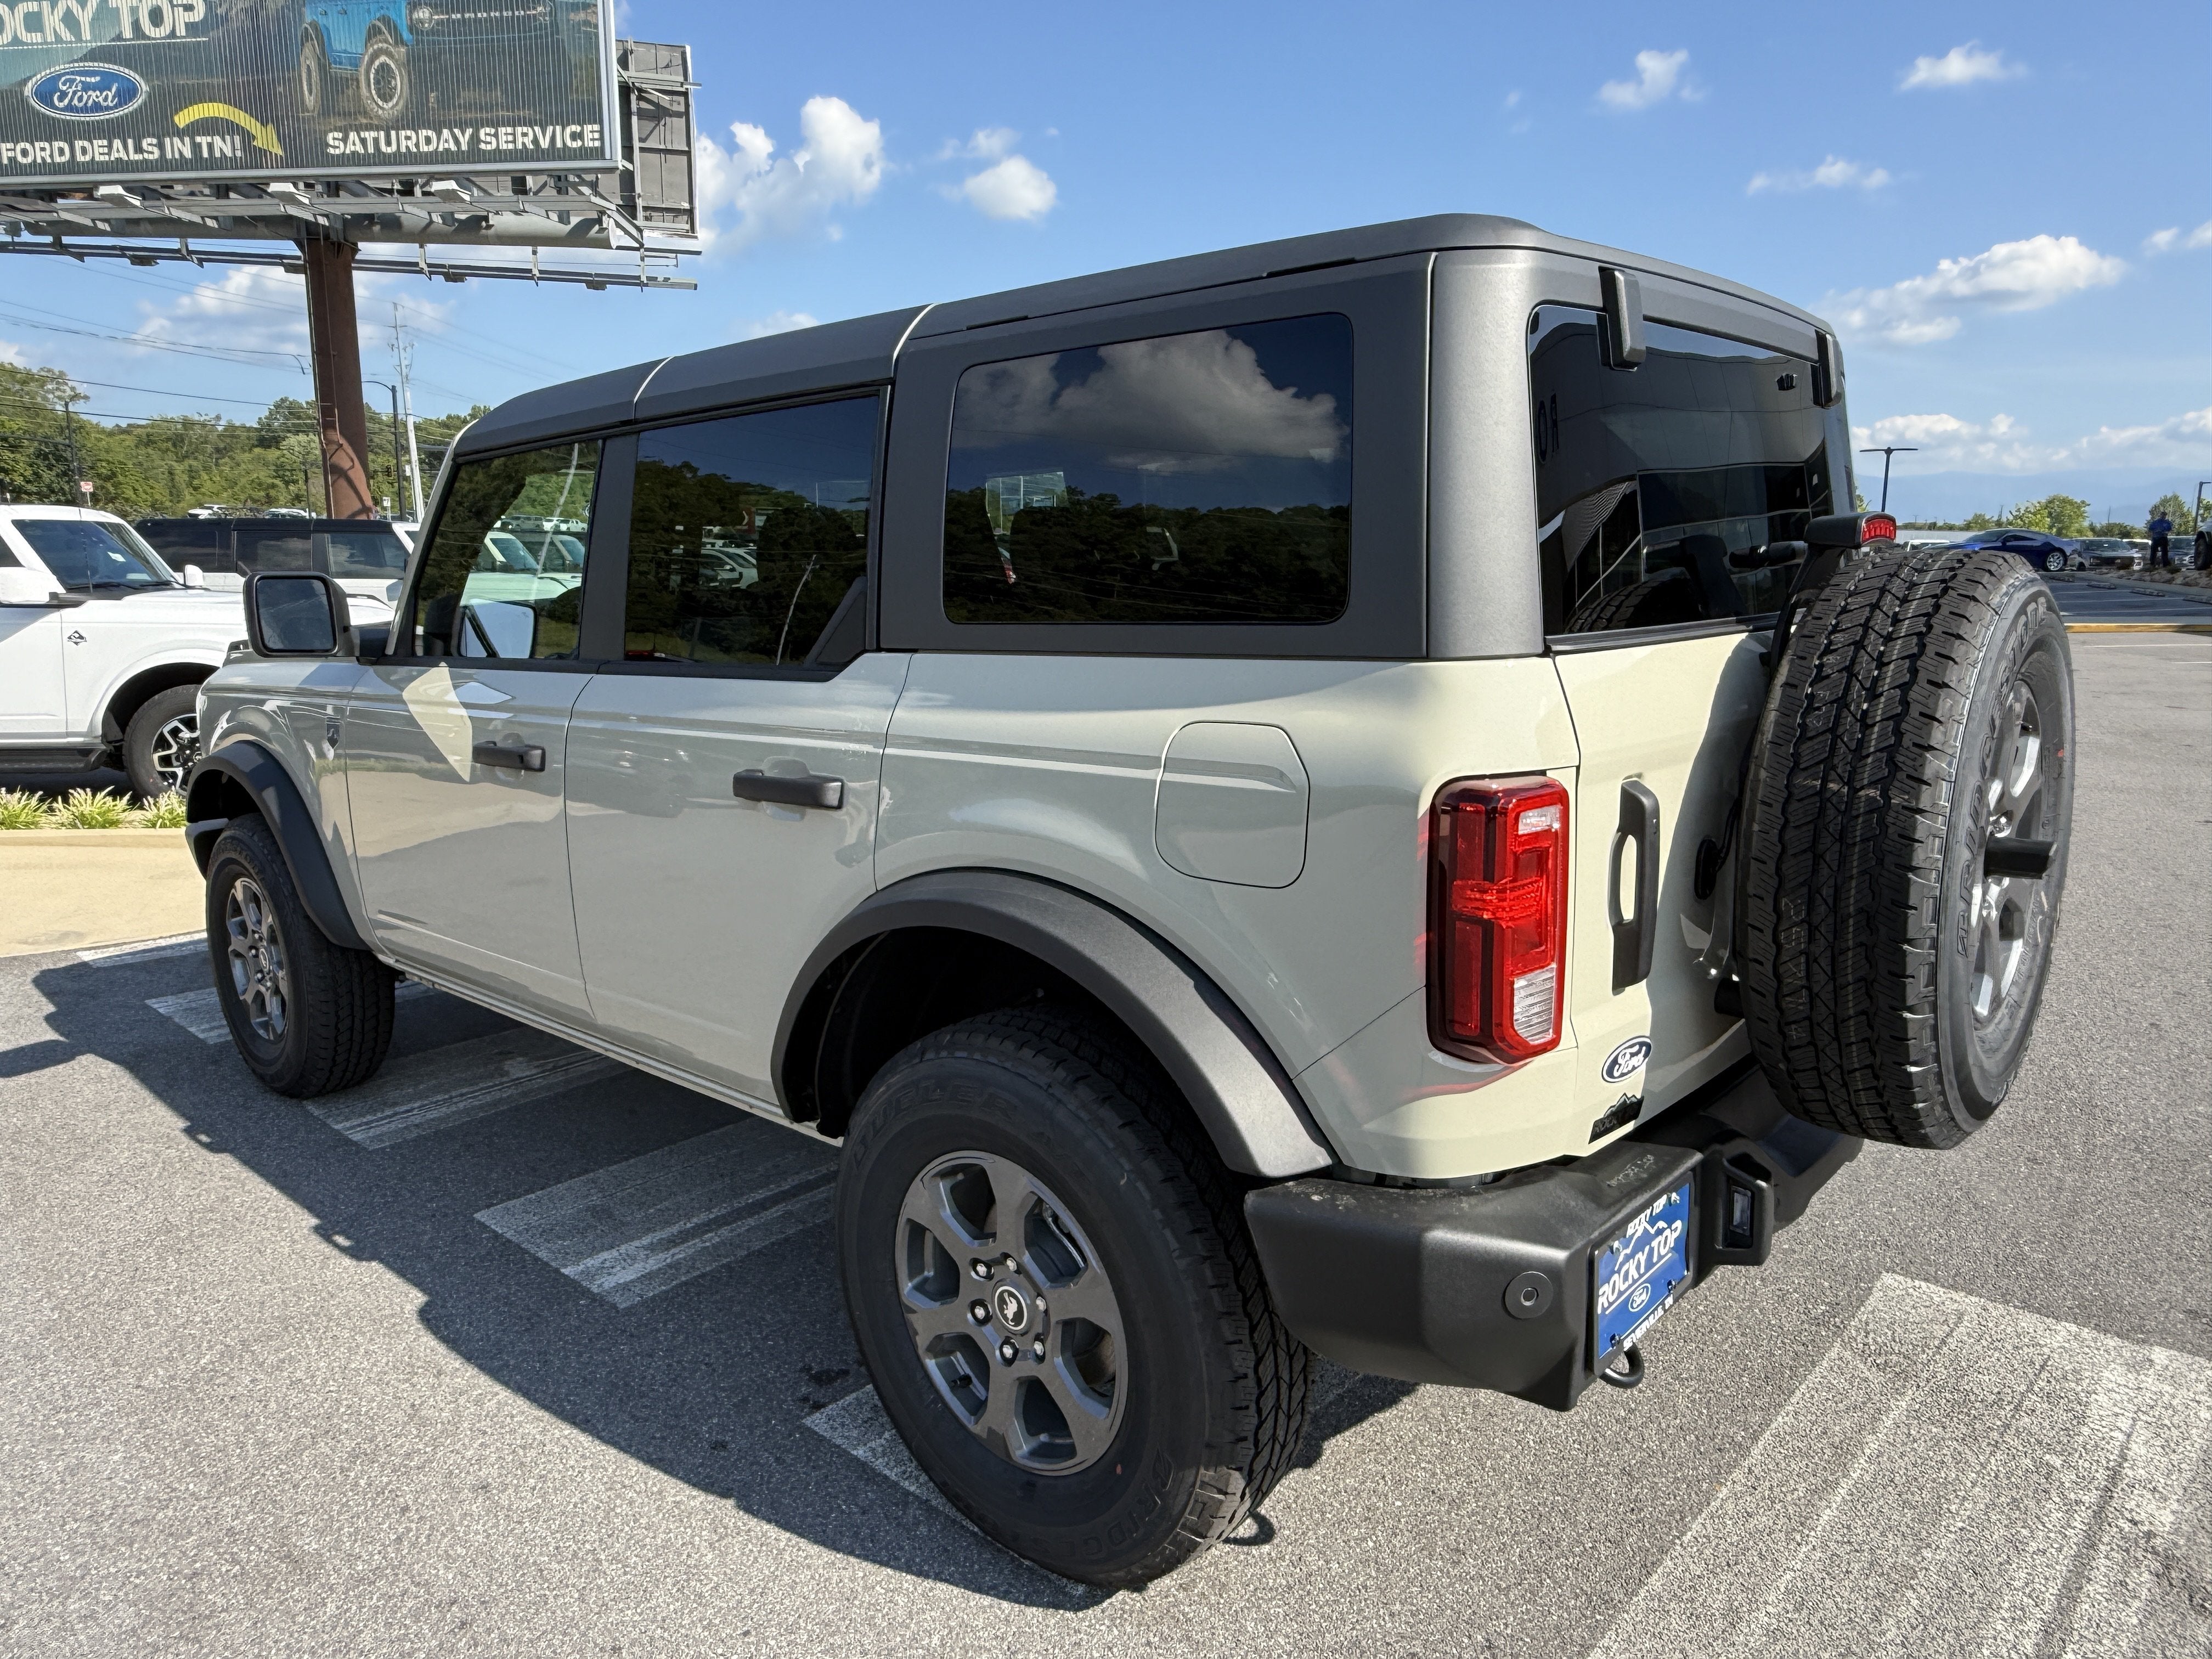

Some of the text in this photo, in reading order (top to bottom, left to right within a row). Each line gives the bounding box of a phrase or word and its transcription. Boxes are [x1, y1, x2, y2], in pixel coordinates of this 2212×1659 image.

[110, 0, 206, 38] TOP
[53, 74, 119, 108] Ford
[1, 134, 242, 164] FORD DEALS IN TN!
[326, 124, 601, 154] SATURDAY SERVICE
[1598, 1220, 1682, 1314] ROCKY TOP
